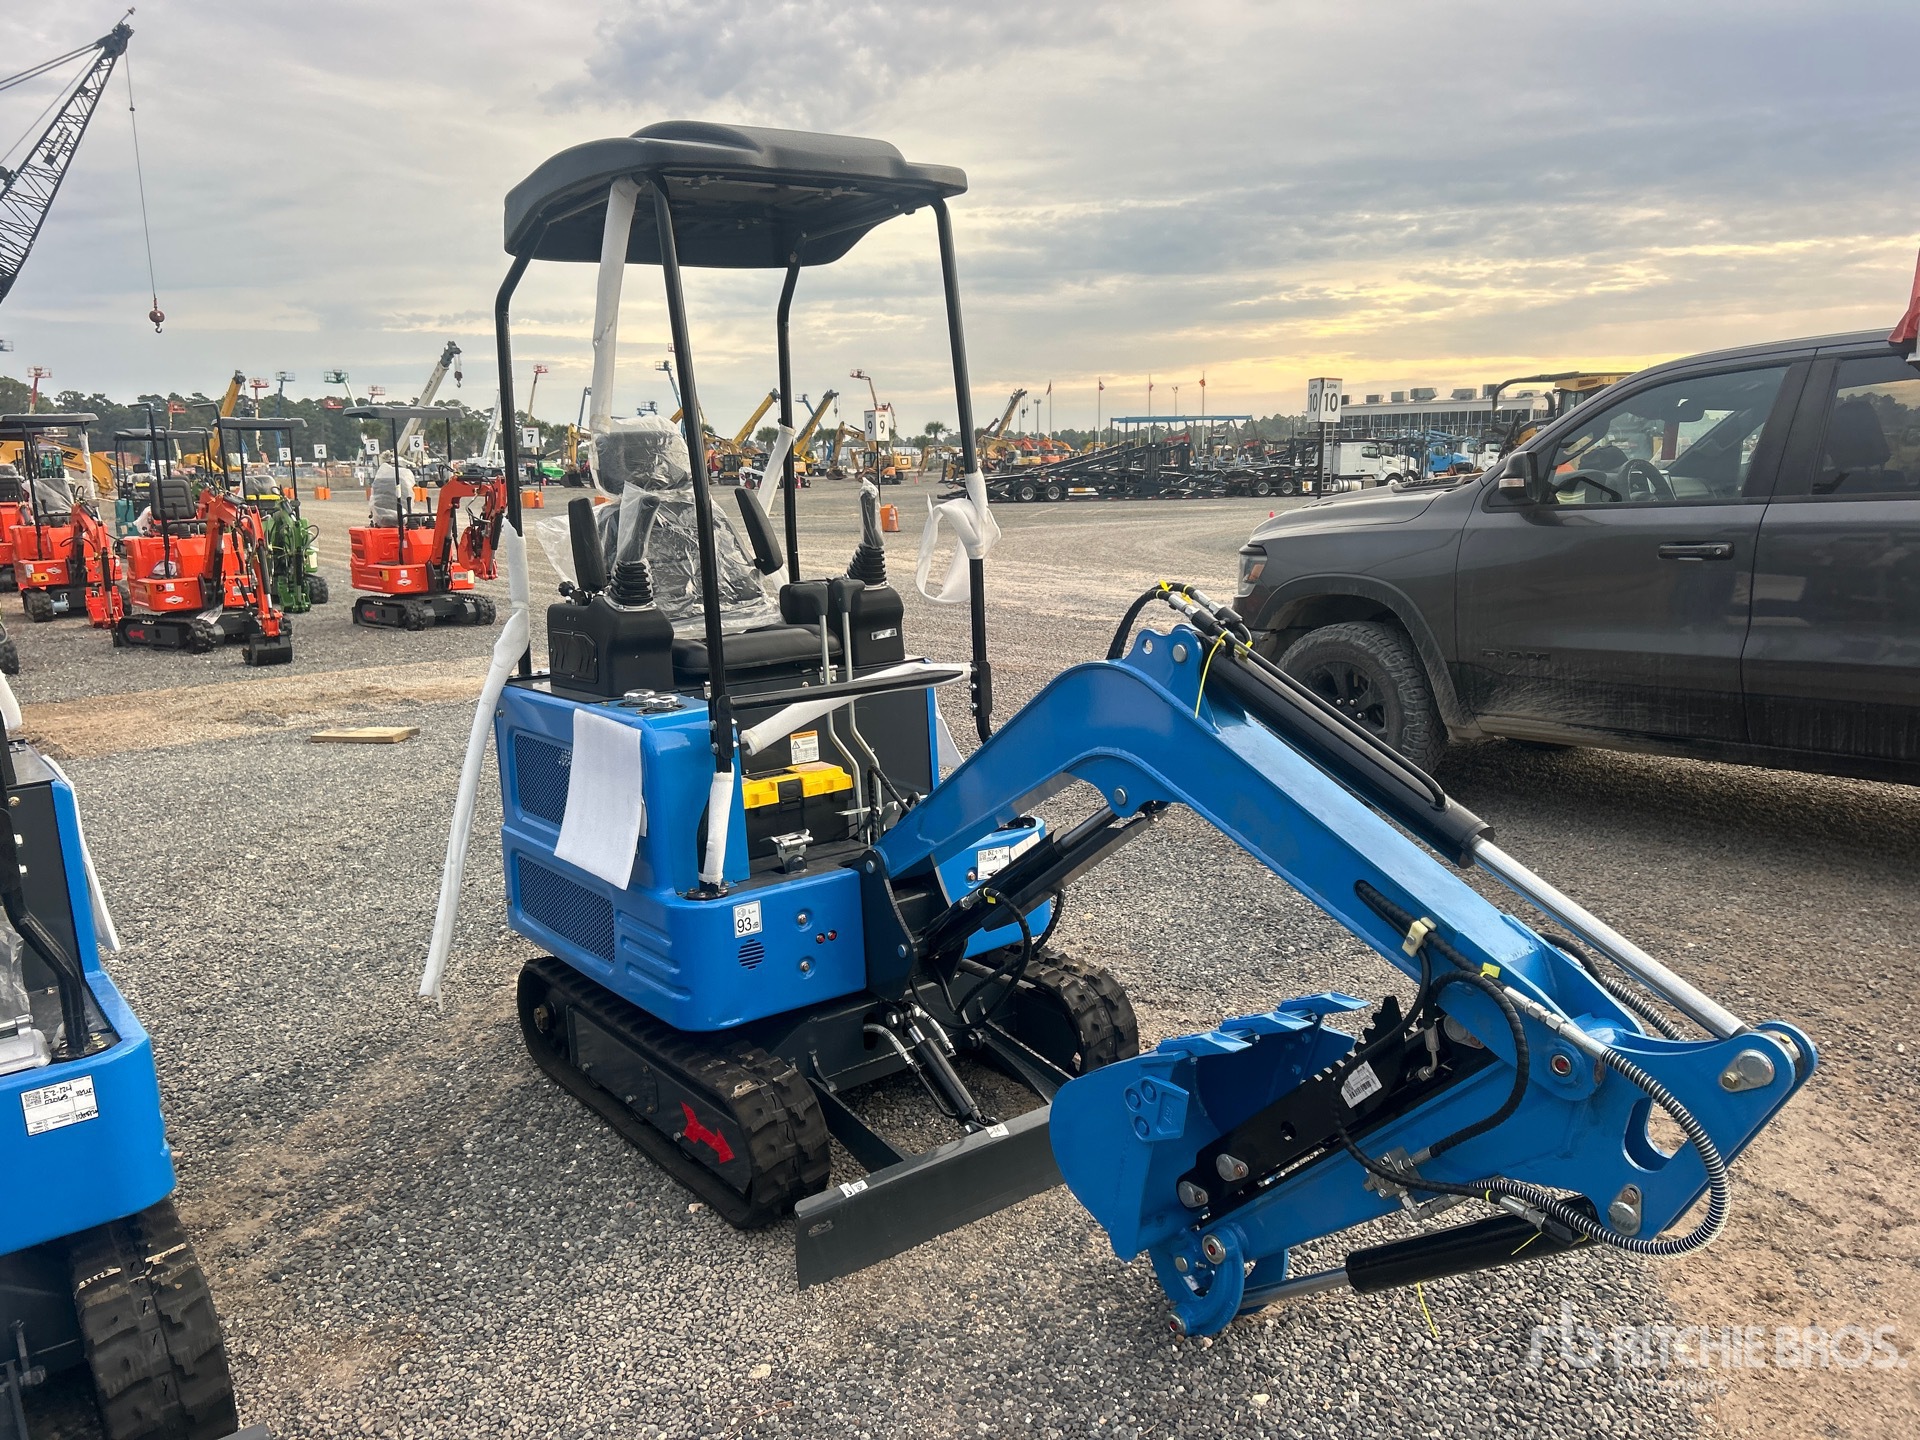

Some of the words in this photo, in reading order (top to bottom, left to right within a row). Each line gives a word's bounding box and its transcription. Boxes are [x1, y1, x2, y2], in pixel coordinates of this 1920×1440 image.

[1309, 392, 1318, 412] 10
[1324, 392, 1338, 412] 10
[867, 420, 873, 434] 9
[879, 420, 885, 434] 9
[414, 440, 420, 448] 6
[527, 434, 534, 443] 7
[737, 917, 752, 933] 93
